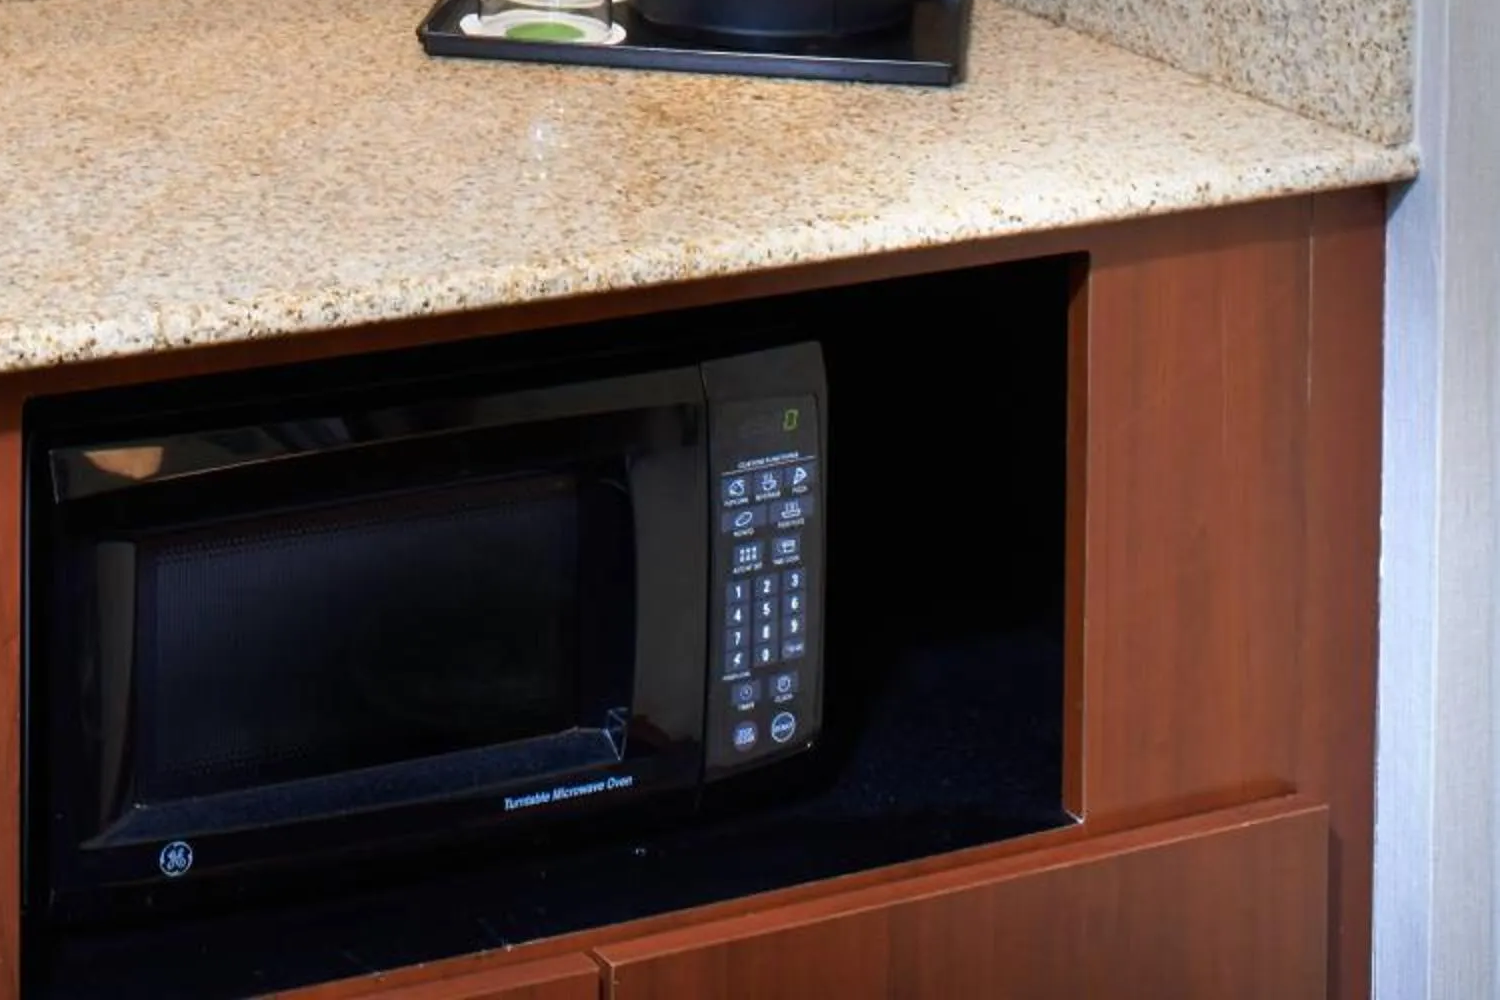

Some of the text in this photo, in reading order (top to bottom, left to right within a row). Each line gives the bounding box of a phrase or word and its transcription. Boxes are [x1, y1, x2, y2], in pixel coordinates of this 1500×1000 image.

[783, 408, 799, 431] 0
[735, 573, 799, 599] 1 2 3
[733, 596, 799, 622] 4 5 6
[735, 631, 741, 646] 7
[791, 618, 798, 633] 9
[504, 776, 633, 811] Turntable Microwave Oven
